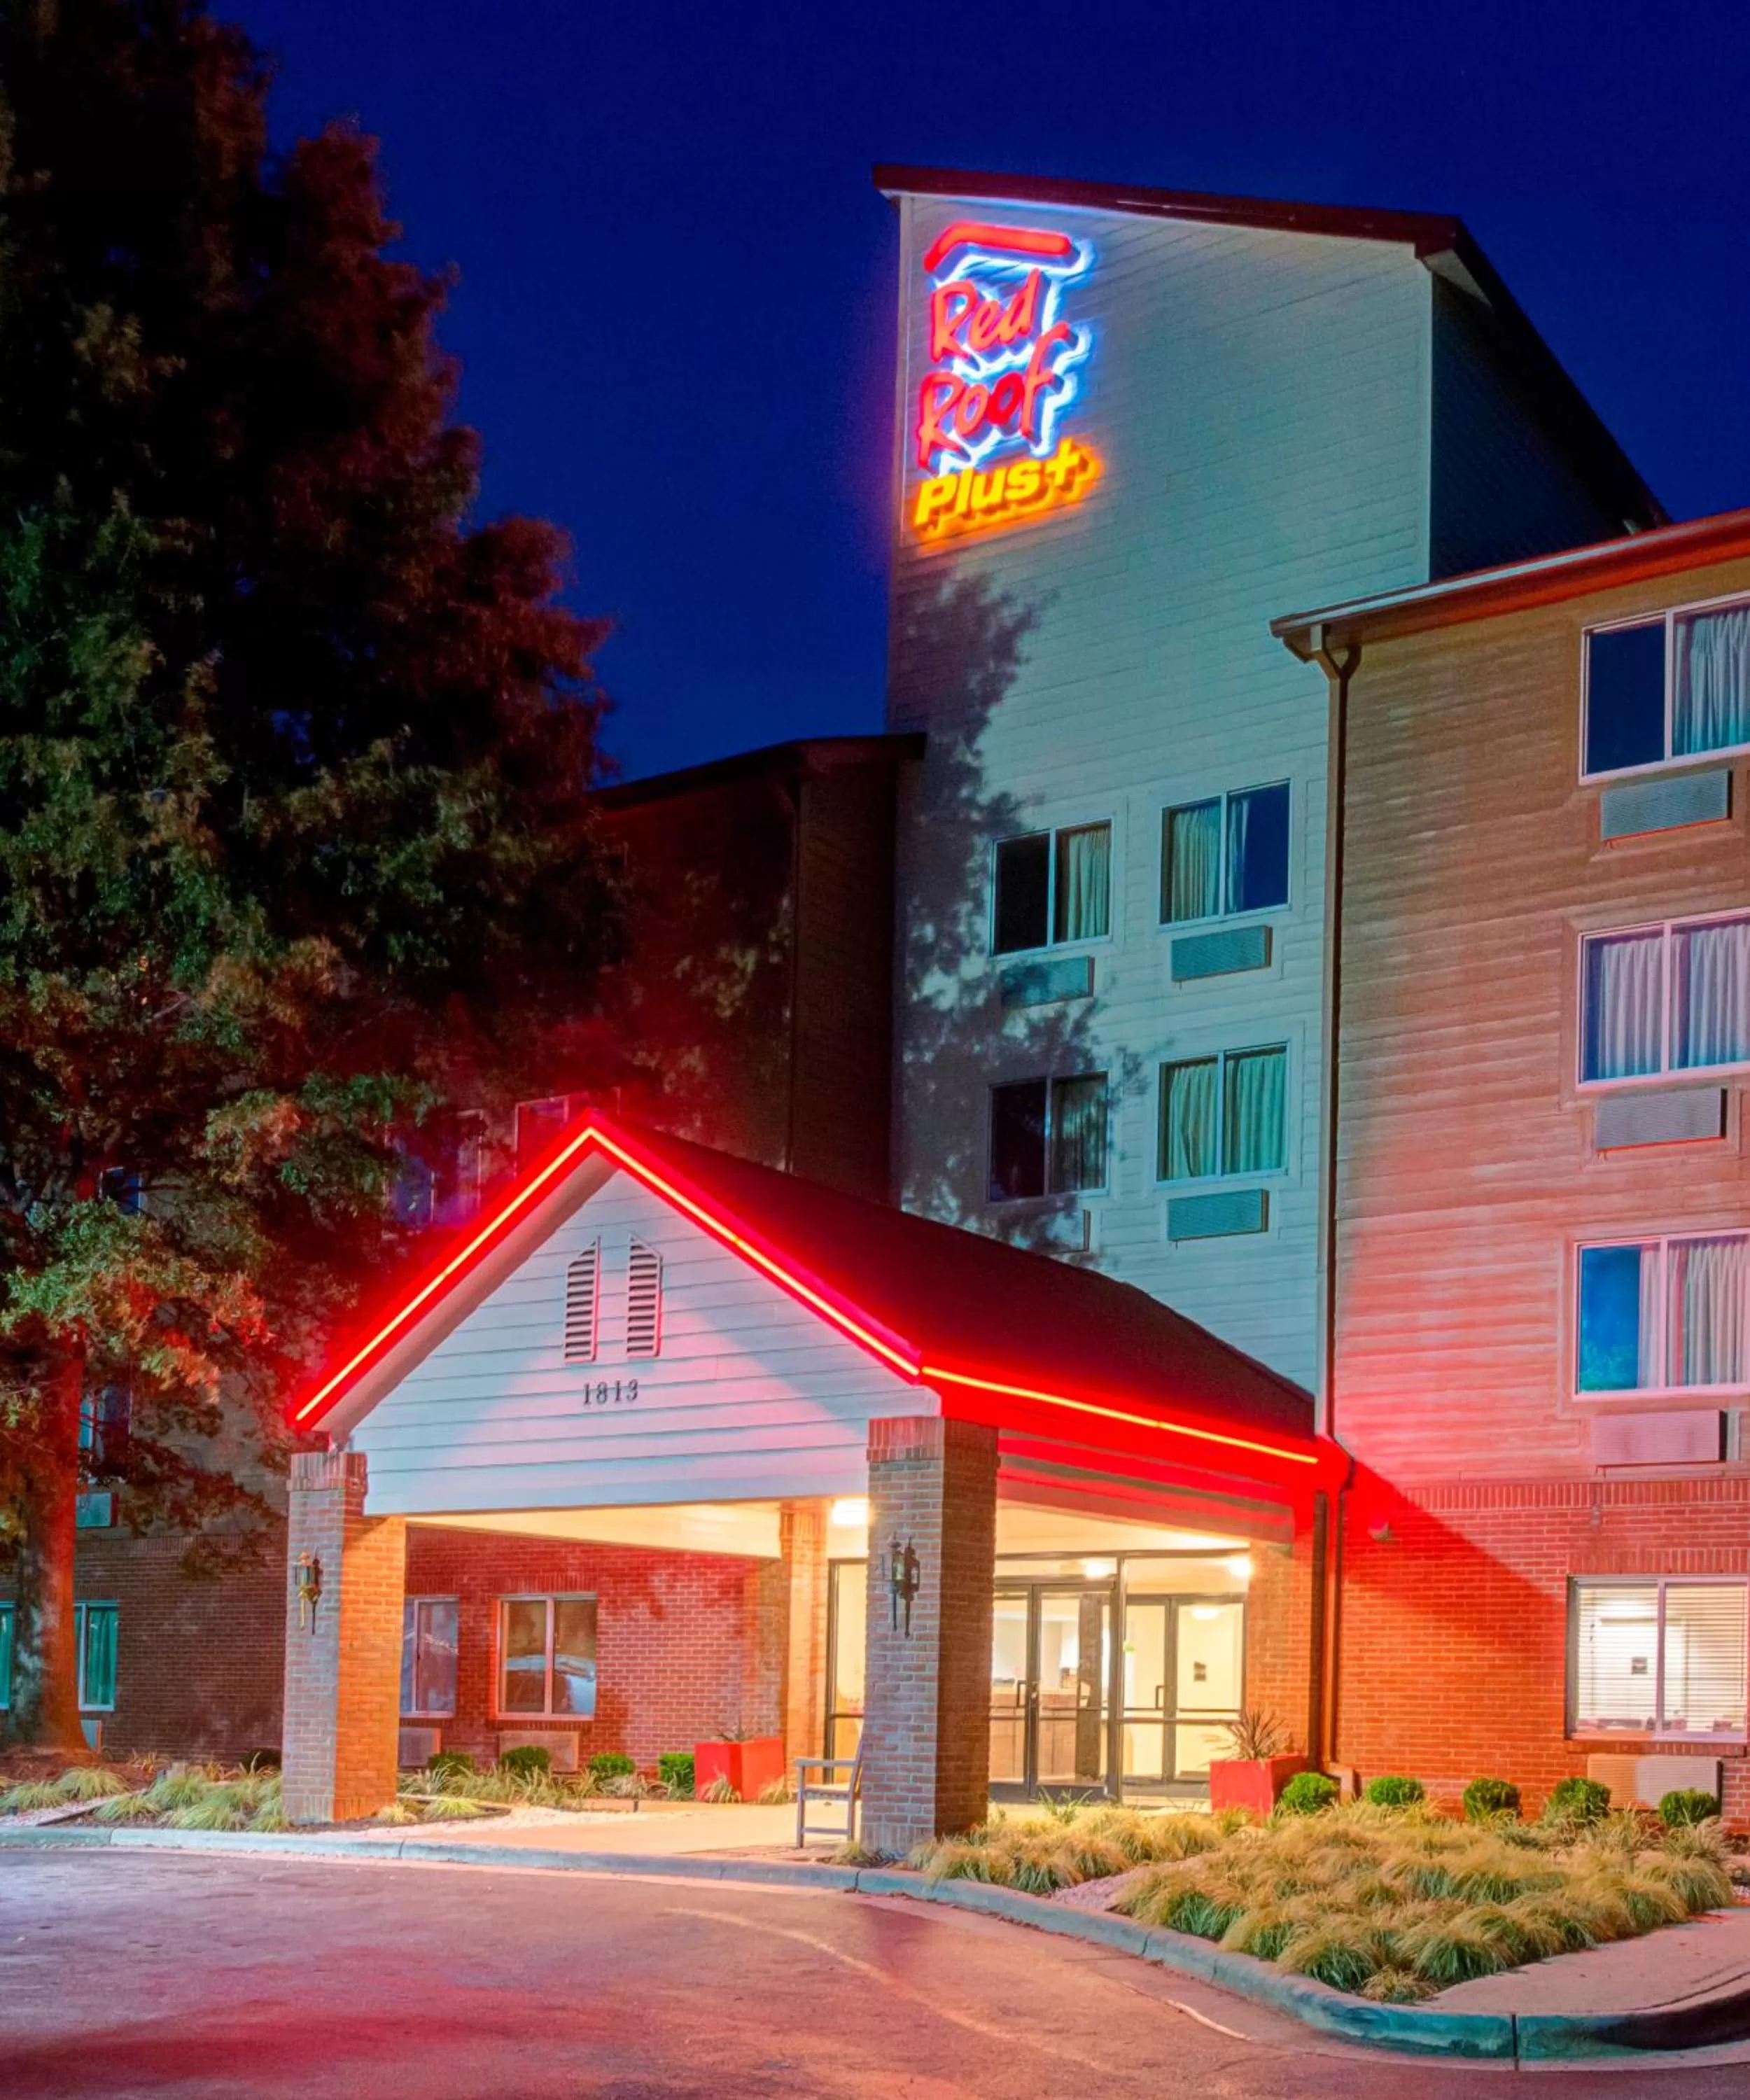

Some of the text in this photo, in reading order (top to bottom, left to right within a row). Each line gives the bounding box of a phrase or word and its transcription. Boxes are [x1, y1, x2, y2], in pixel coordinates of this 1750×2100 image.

[931, 268, 1041, 363] Red
[917, 322, 1069, 470] Roof
[583, 1378, 638, 1406] 1813
